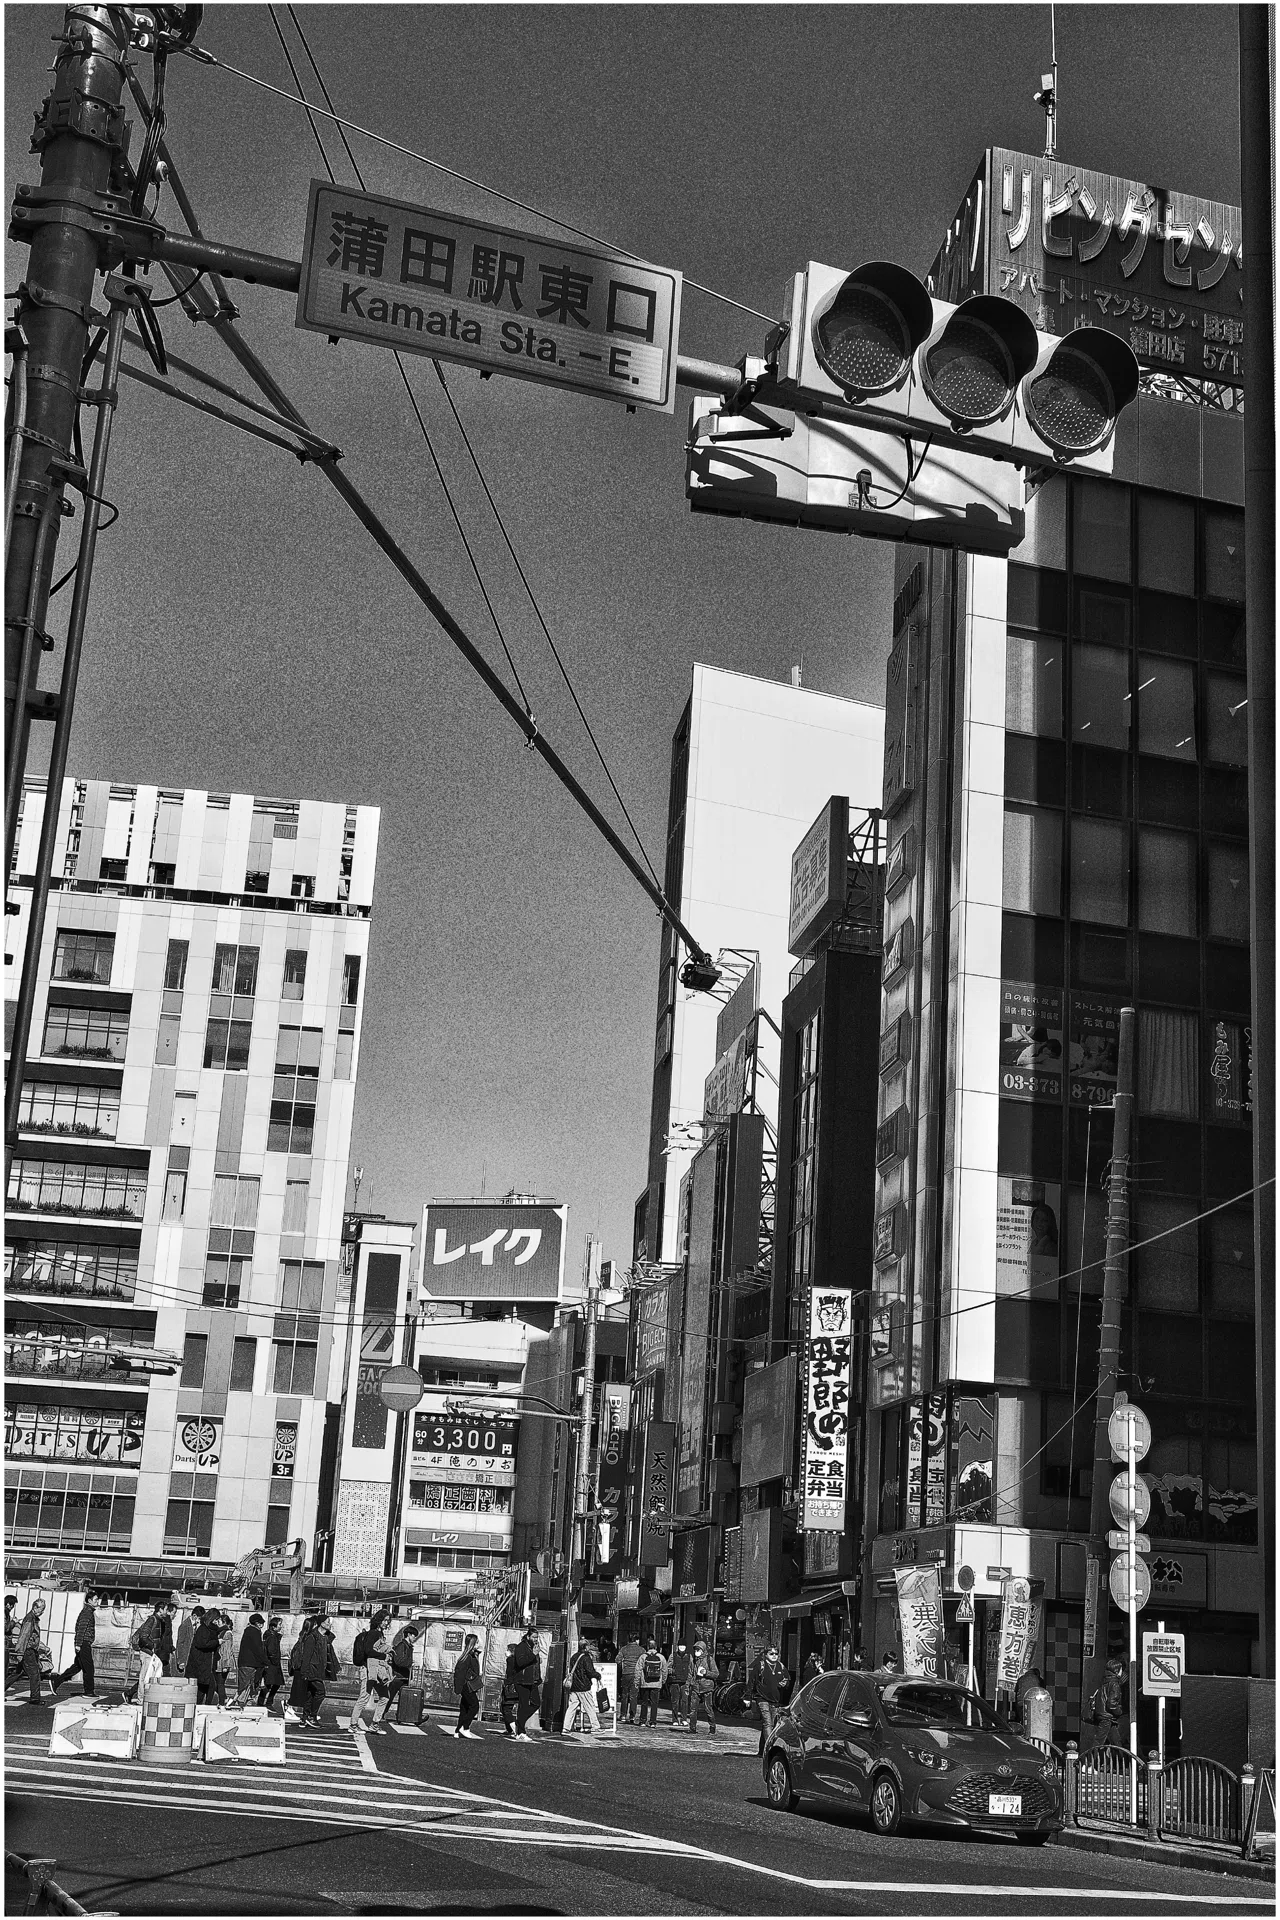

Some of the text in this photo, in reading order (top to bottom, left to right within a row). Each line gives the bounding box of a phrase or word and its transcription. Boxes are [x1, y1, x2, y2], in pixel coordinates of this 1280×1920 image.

[1001, 163, 1243, 304] リビングセン
[325, 210, 657, 343] 蒲田駅東口
[1001, 265, 1244, 345] アパート・マンション・駐車
[340, 282, 482, 346] Kamata
[500, 321, 567, 367] Sta.
[1203, 344, 1245, 376] 571
[433, 1228, 542, 1266] レイク
[415, 1430, 427, 1438] 60
[432, 1427, 513, 1455] 3,300 円
[175, 1453, 220, 1468] Darts UP
[275, 1449, 294, 1462] UP
[807, 1460, 845, 1478] 定食
[277, 1464, 290, 1476] 3F
[807, 1480, 843, 1498] 弁当
[431, 1532, 459, 1544] レイク
[1147, 1555, 1184, 1586] 松
